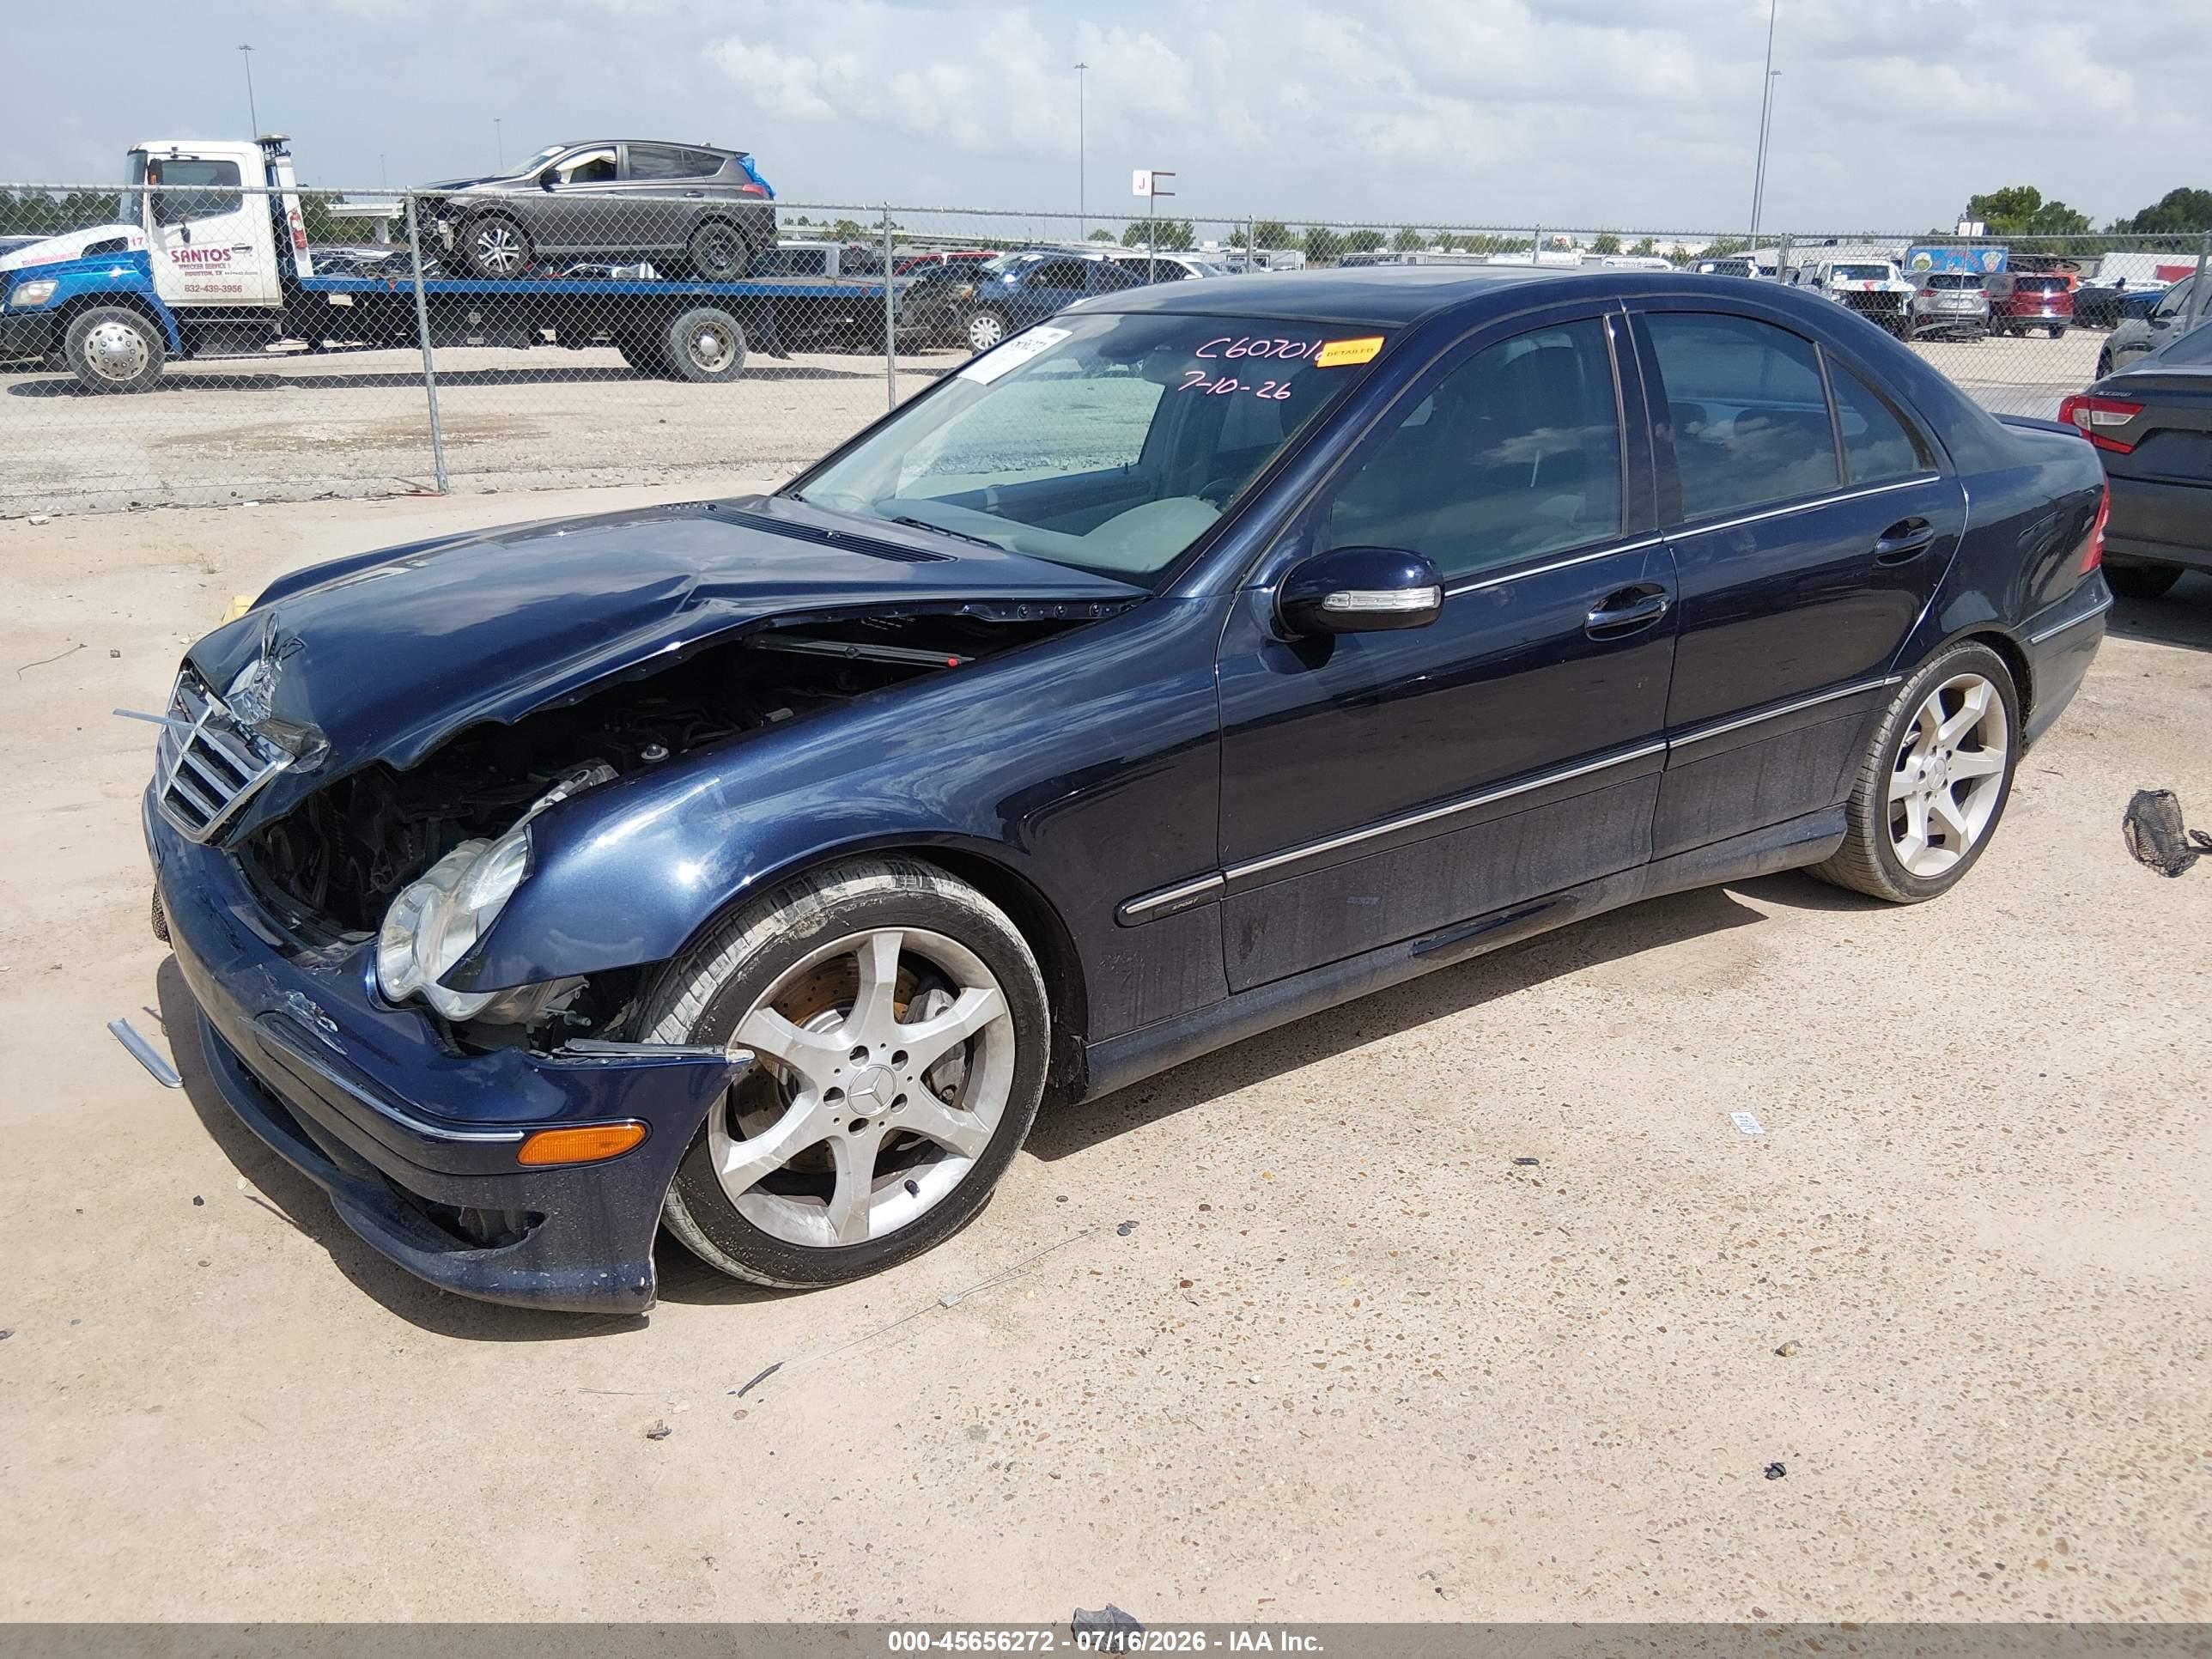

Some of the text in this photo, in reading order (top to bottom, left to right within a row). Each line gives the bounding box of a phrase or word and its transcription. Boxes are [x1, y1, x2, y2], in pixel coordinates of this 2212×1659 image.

[1139, 177, 1146, 190] J
[131, 237, 144, 246] 17
[171, 248, 232, 263] SANTOS
[185, 284, 243, 293] 832-439-3956
[1326, 348, 1375, 357] DETAILED
